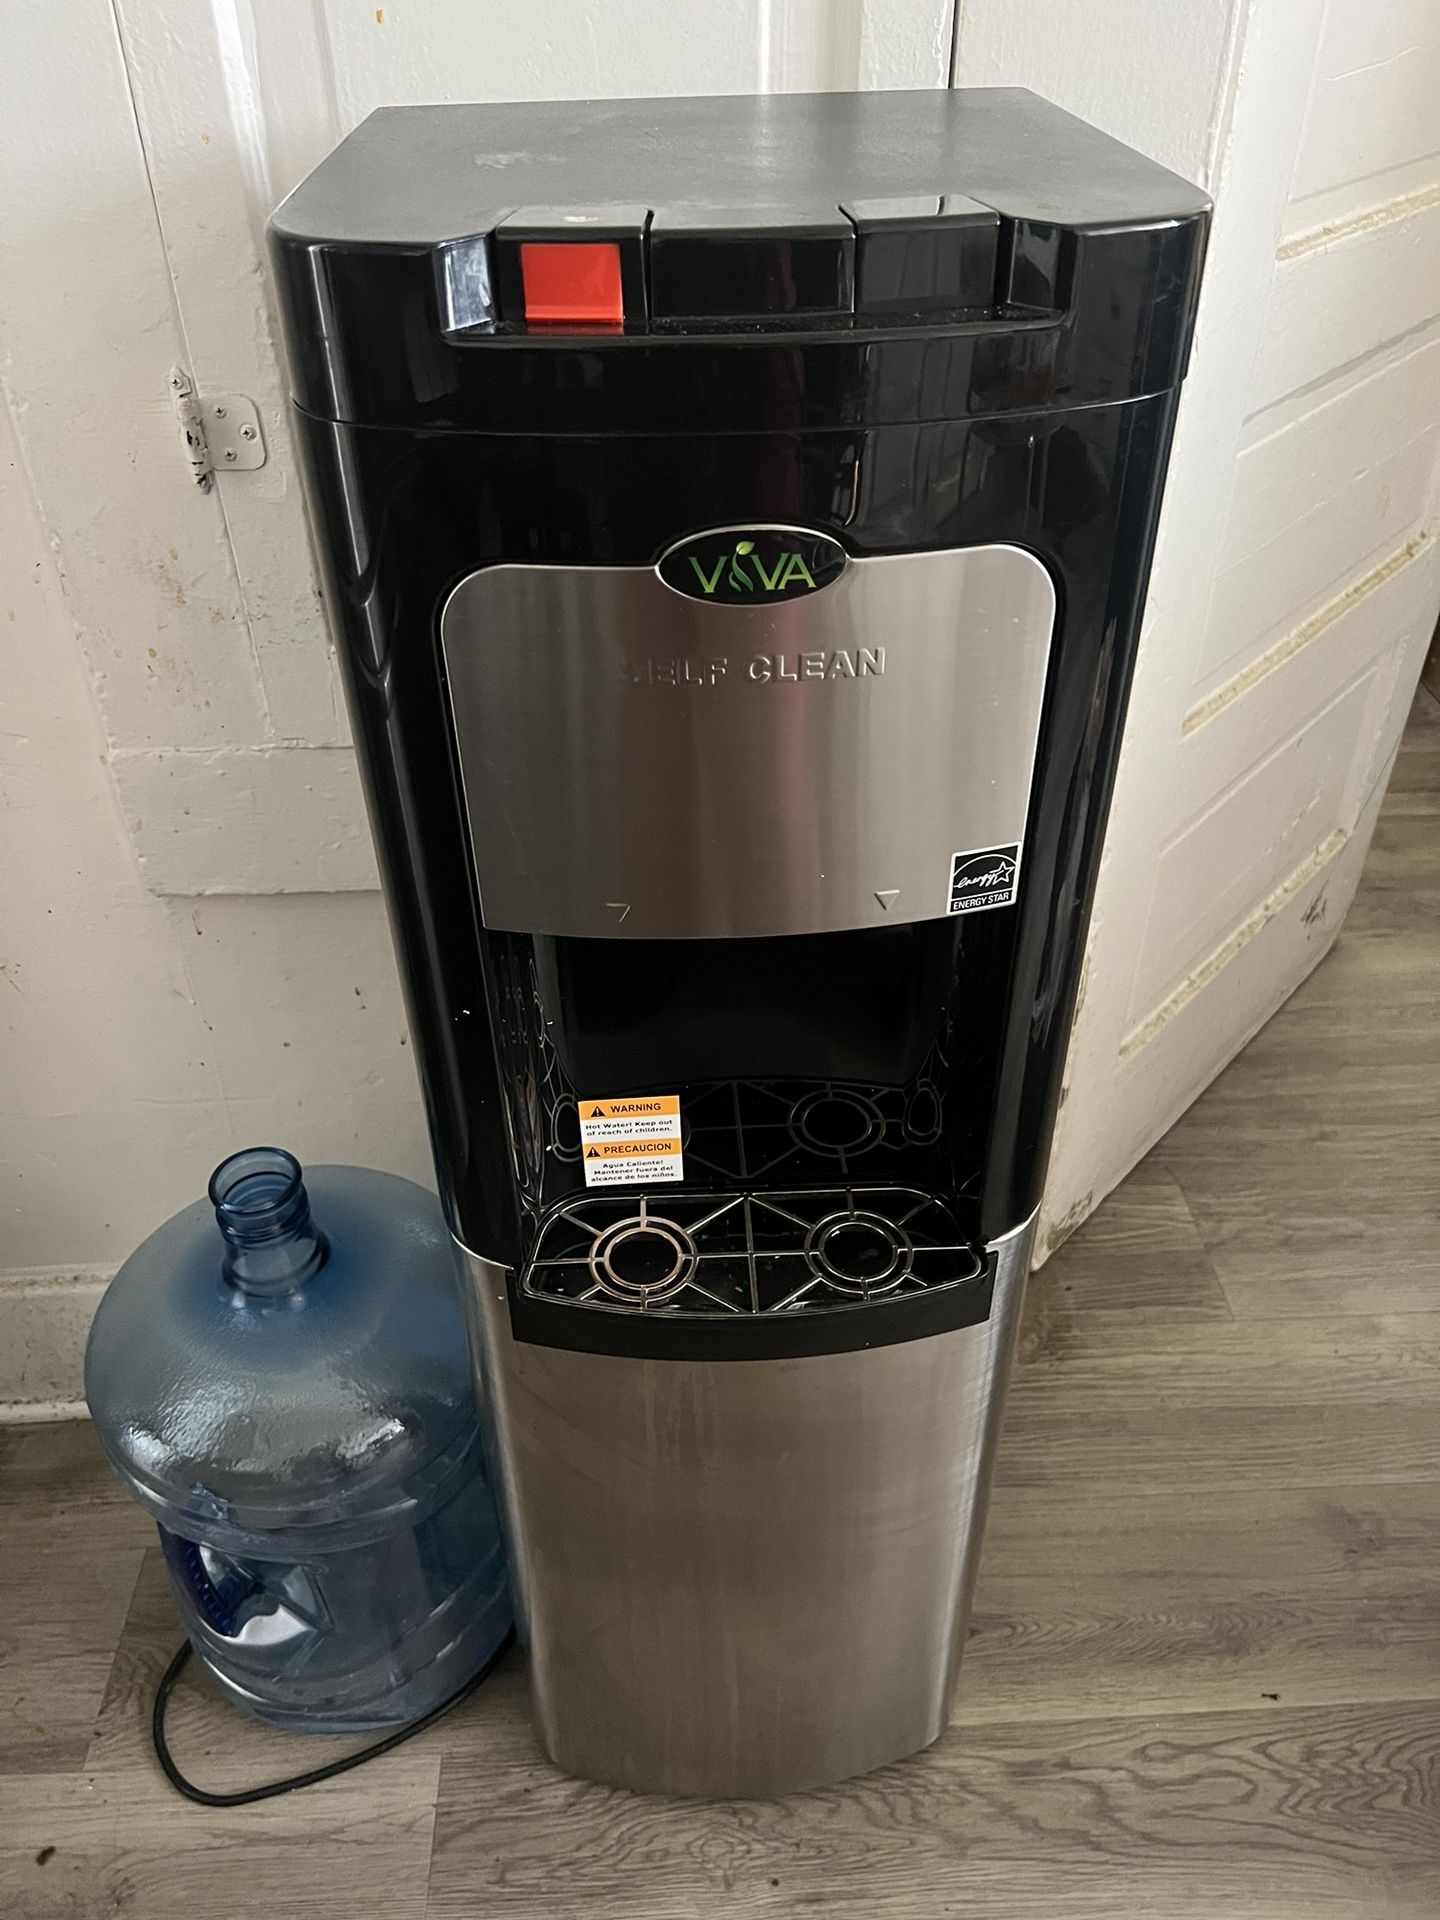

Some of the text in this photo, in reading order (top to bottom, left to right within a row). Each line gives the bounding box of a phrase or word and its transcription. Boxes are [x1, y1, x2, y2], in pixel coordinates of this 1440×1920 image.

[629, 646, 887, 686] ELF CLEAN
[953, 892, 1010, 910] ENERGY STAR
[611, 1102, 661, 1113] WARNING
[603, 1121, 632, 1129] Water!
[635, 1120, 656, 1128] Keep
[635, 1126, 672, 1134] children.
[604, 1143, 672, 1154] PRECAUCION
[626, 1159, 664, 1167] Caliente!
[594, 1168, 633, 1176] Mantener
[591, 1175, 623, 1183] alcance
